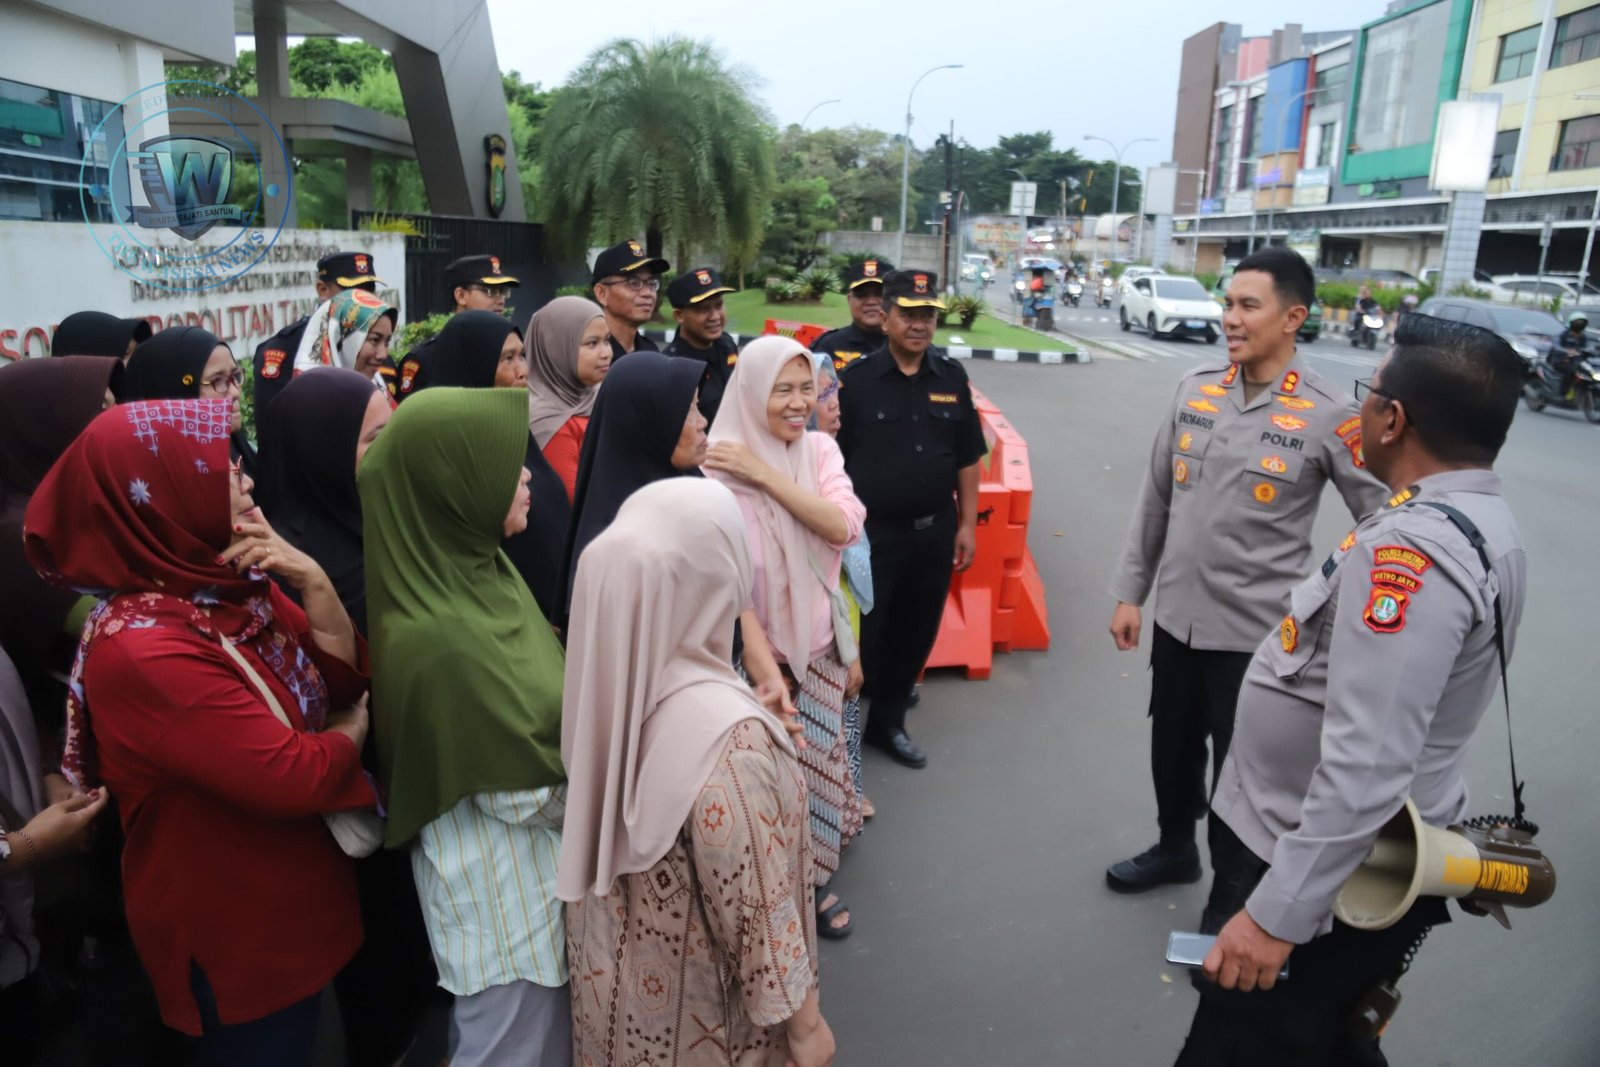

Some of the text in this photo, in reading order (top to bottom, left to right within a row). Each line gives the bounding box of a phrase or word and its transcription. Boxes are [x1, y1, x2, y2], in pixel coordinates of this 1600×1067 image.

[1260, 431, 1304, 452] POLRI
[1374, 572, 1416, 589] METRO JAYA
